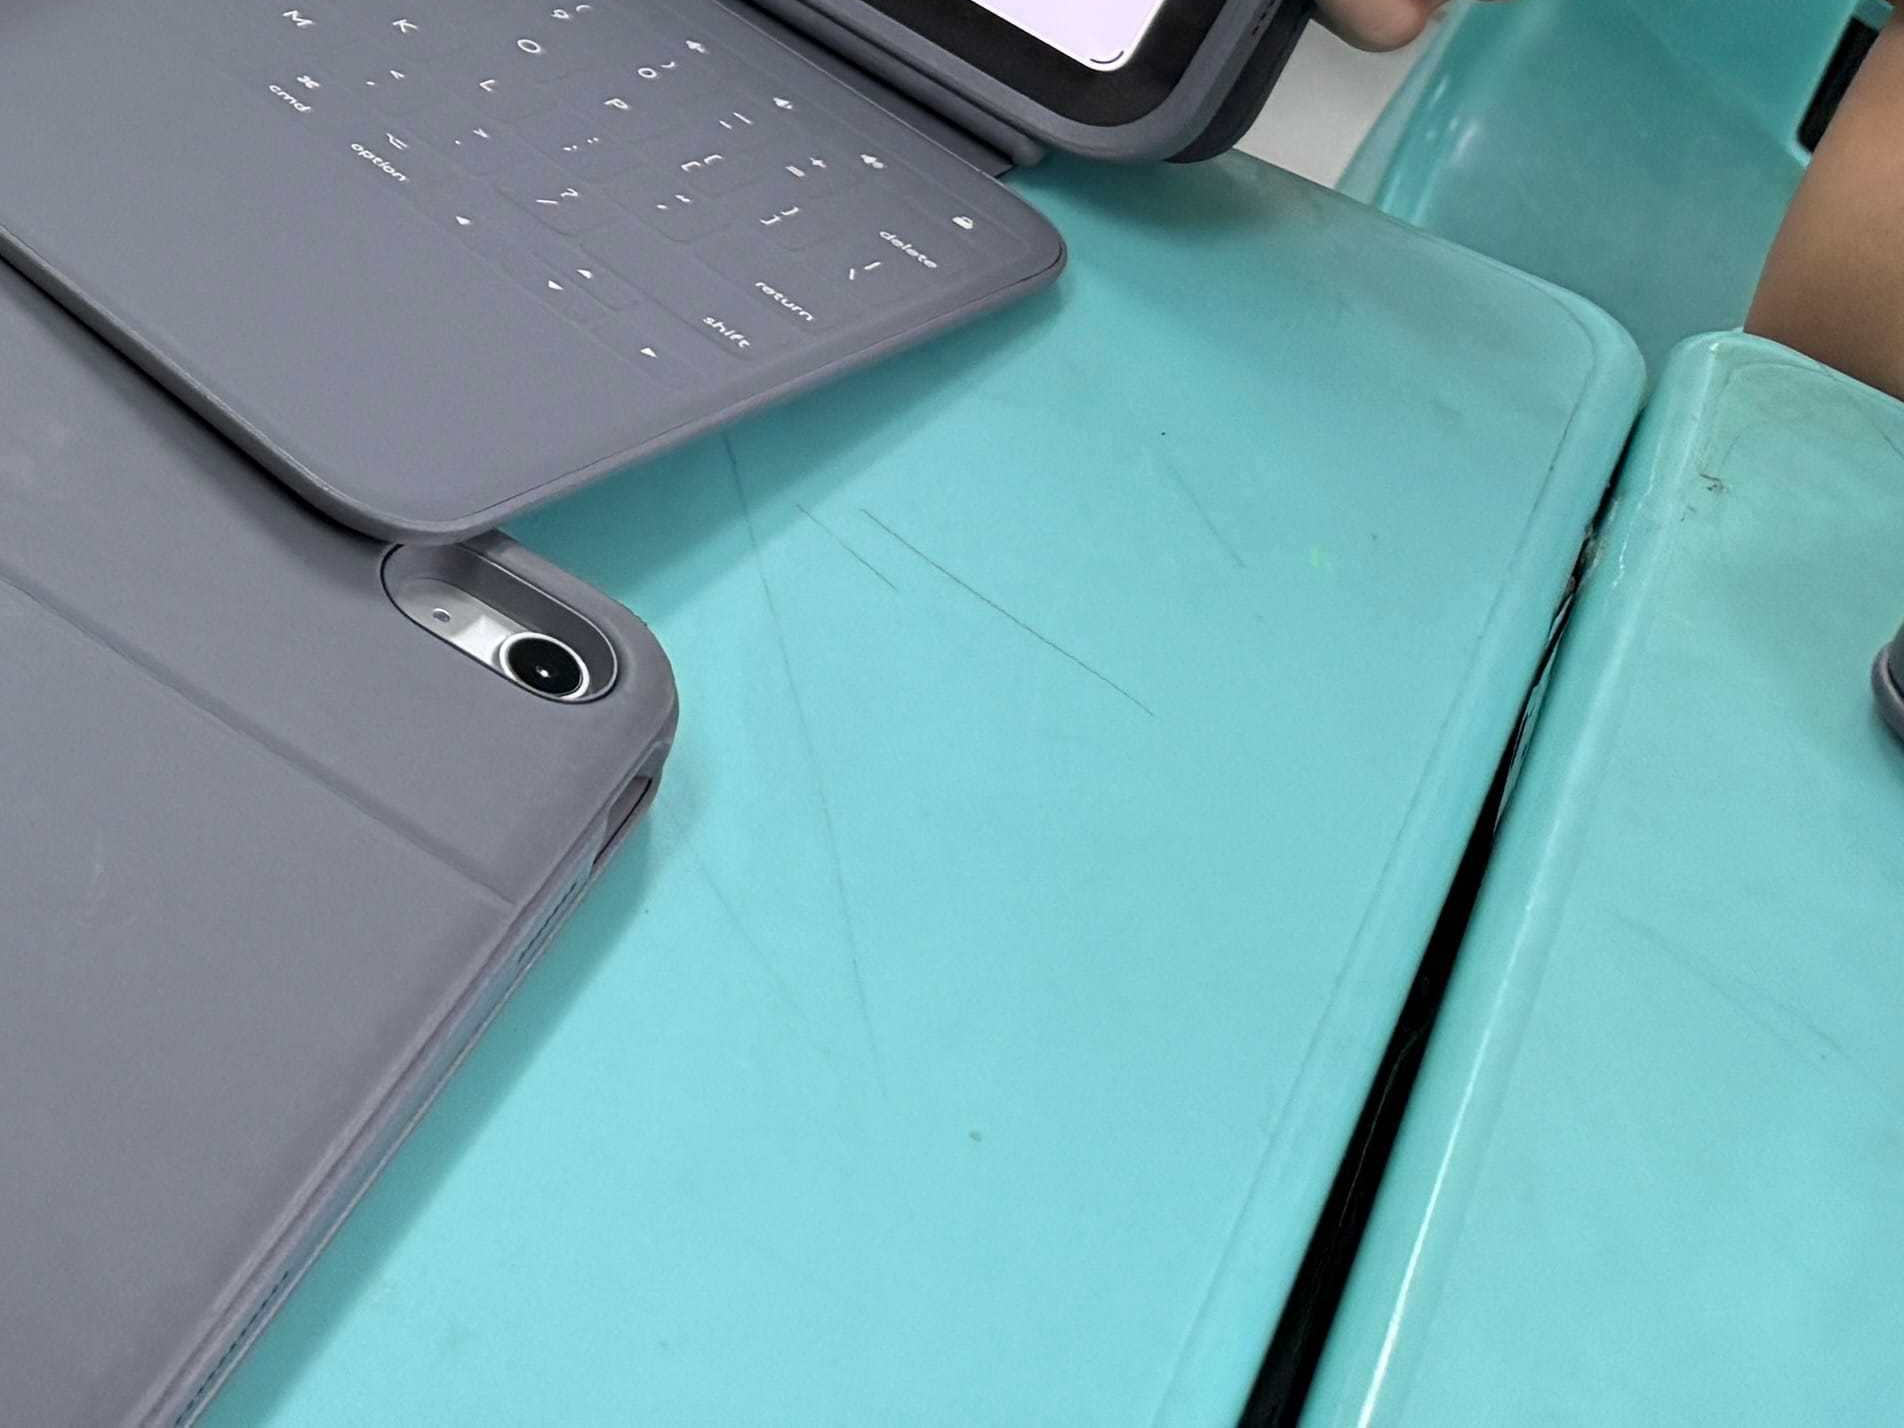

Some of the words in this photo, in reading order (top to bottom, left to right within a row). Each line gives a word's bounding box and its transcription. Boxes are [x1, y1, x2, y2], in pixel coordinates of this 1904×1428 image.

[282, 10, 314, 27] M
[392, 18, 418, 33] K
[517, 38, 542, 54] O
[637, 67, 658, 79] 0
[479, 79, 496, 92] L
[268, 84, 312, 112] cmd
[604, 98, 629, 110] P
[351, 143, 407, 182] option
[879, 231, 938, 269] delete
[755, 281, 814, 321] return
[703, 317, 751, 348] shift
